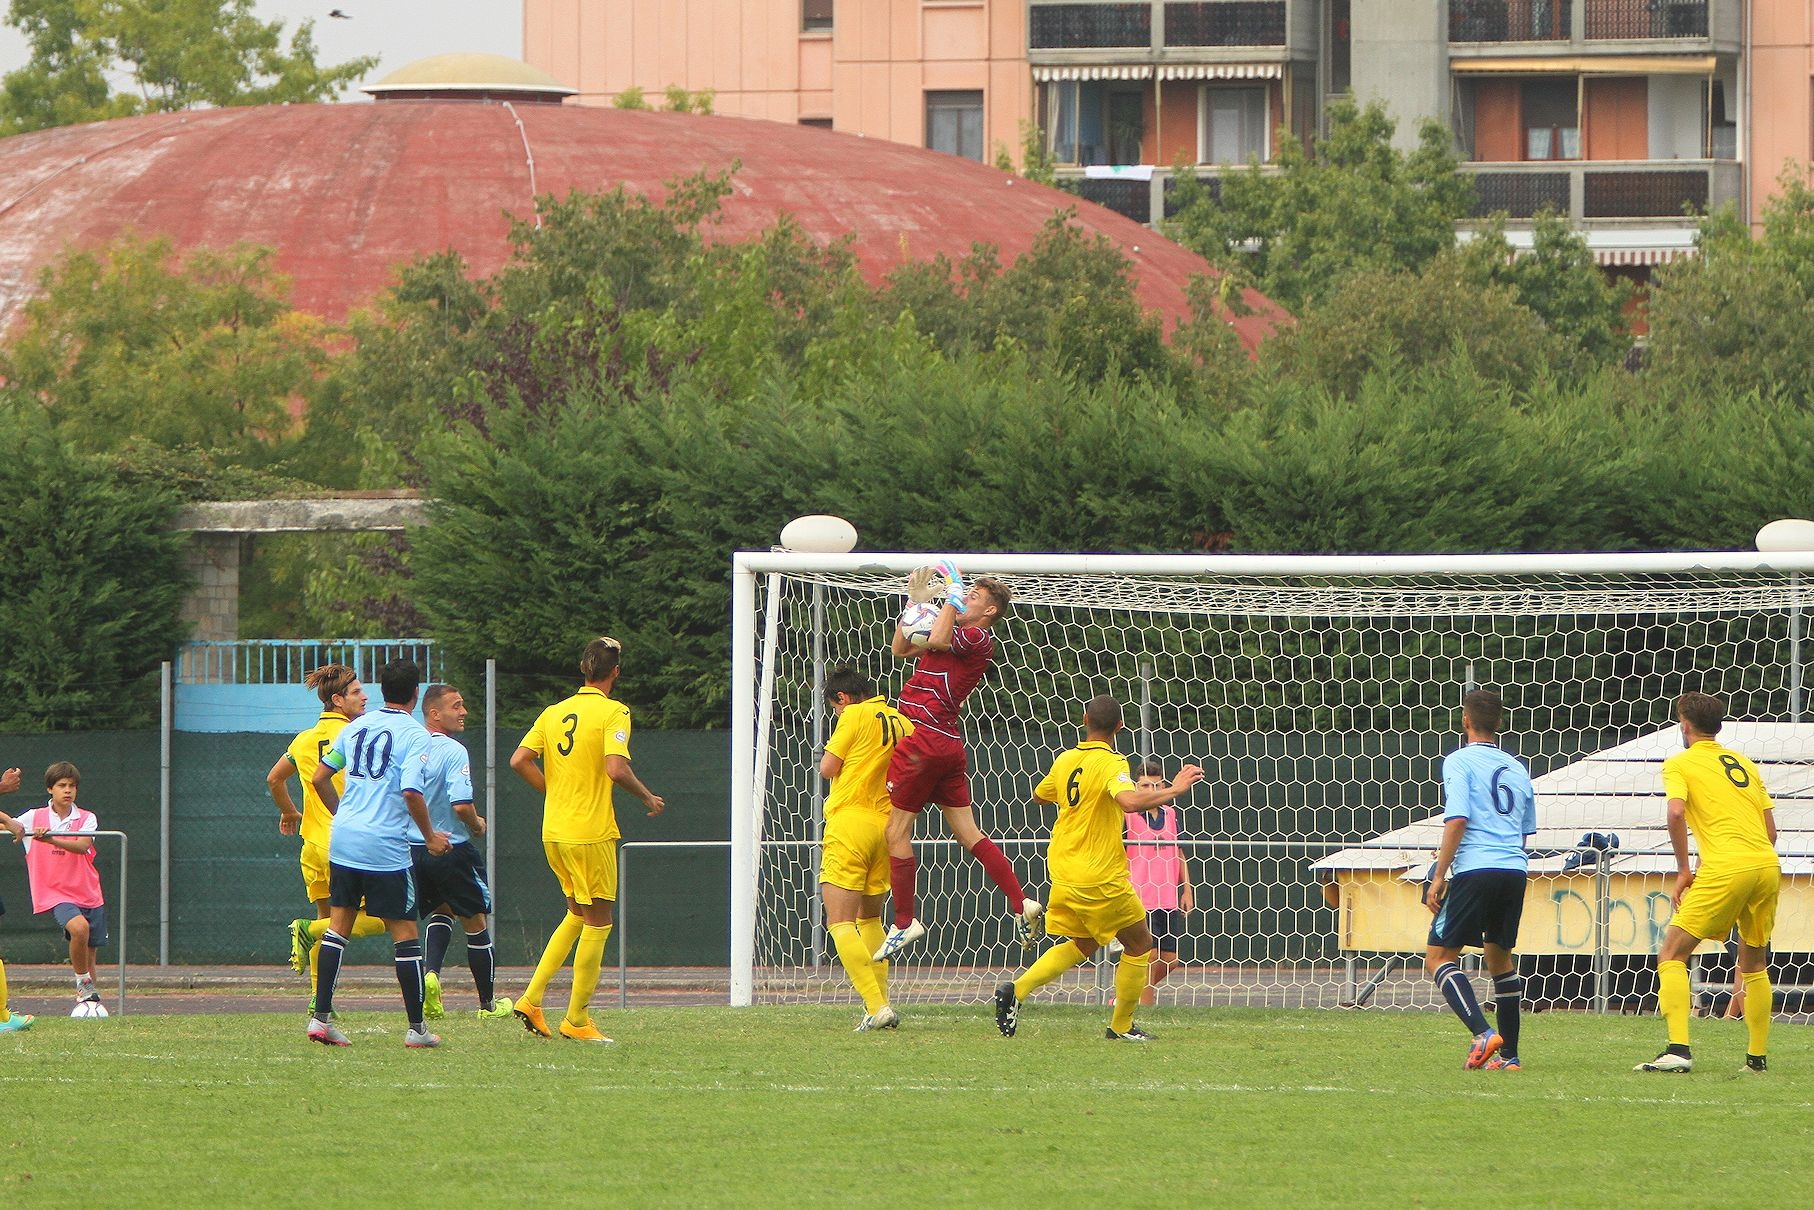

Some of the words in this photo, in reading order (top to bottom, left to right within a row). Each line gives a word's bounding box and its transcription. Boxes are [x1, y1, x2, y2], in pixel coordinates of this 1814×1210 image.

[349, 727, 394, 781] 10
[557, 713, 578, 757] 3
[1066, 767, 1084, 807] 6
[1490, 766, 1515, 816] 6
[1717, 753, 1750, 788] 8
